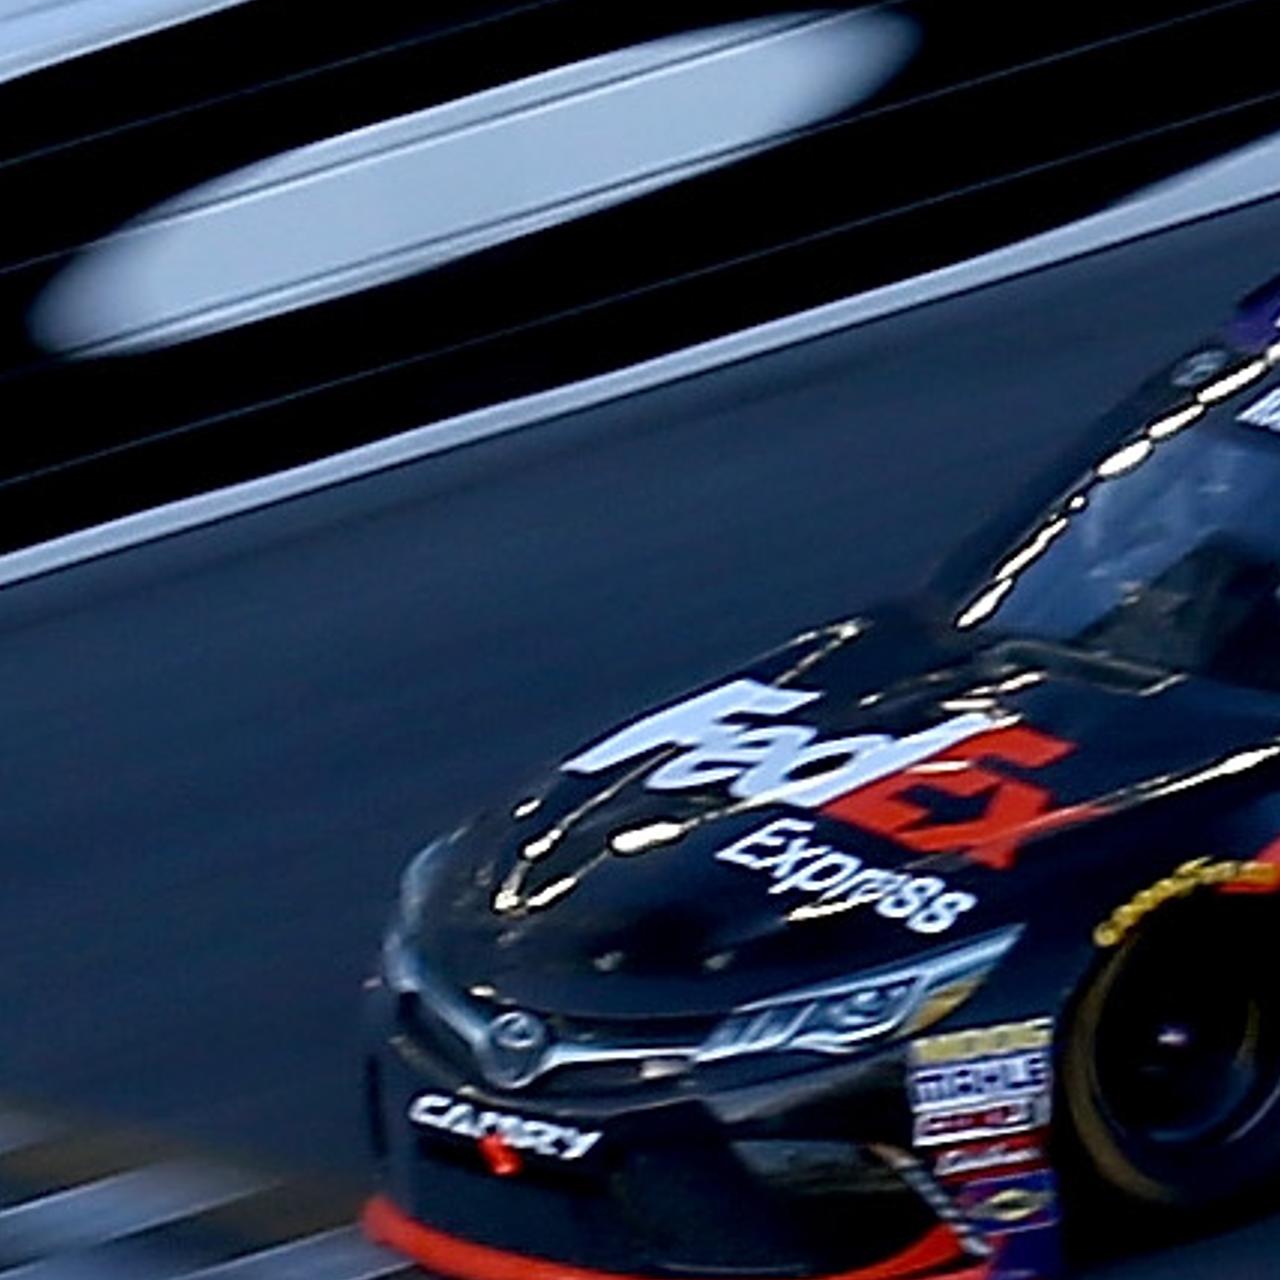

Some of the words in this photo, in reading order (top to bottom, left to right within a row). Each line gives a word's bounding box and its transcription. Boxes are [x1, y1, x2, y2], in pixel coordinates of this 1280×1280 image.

[560, 678, 1080, 870] FedEx
[715, 818, 977, 934] Express
[409, 1094, 603, 1160] CAMRY
